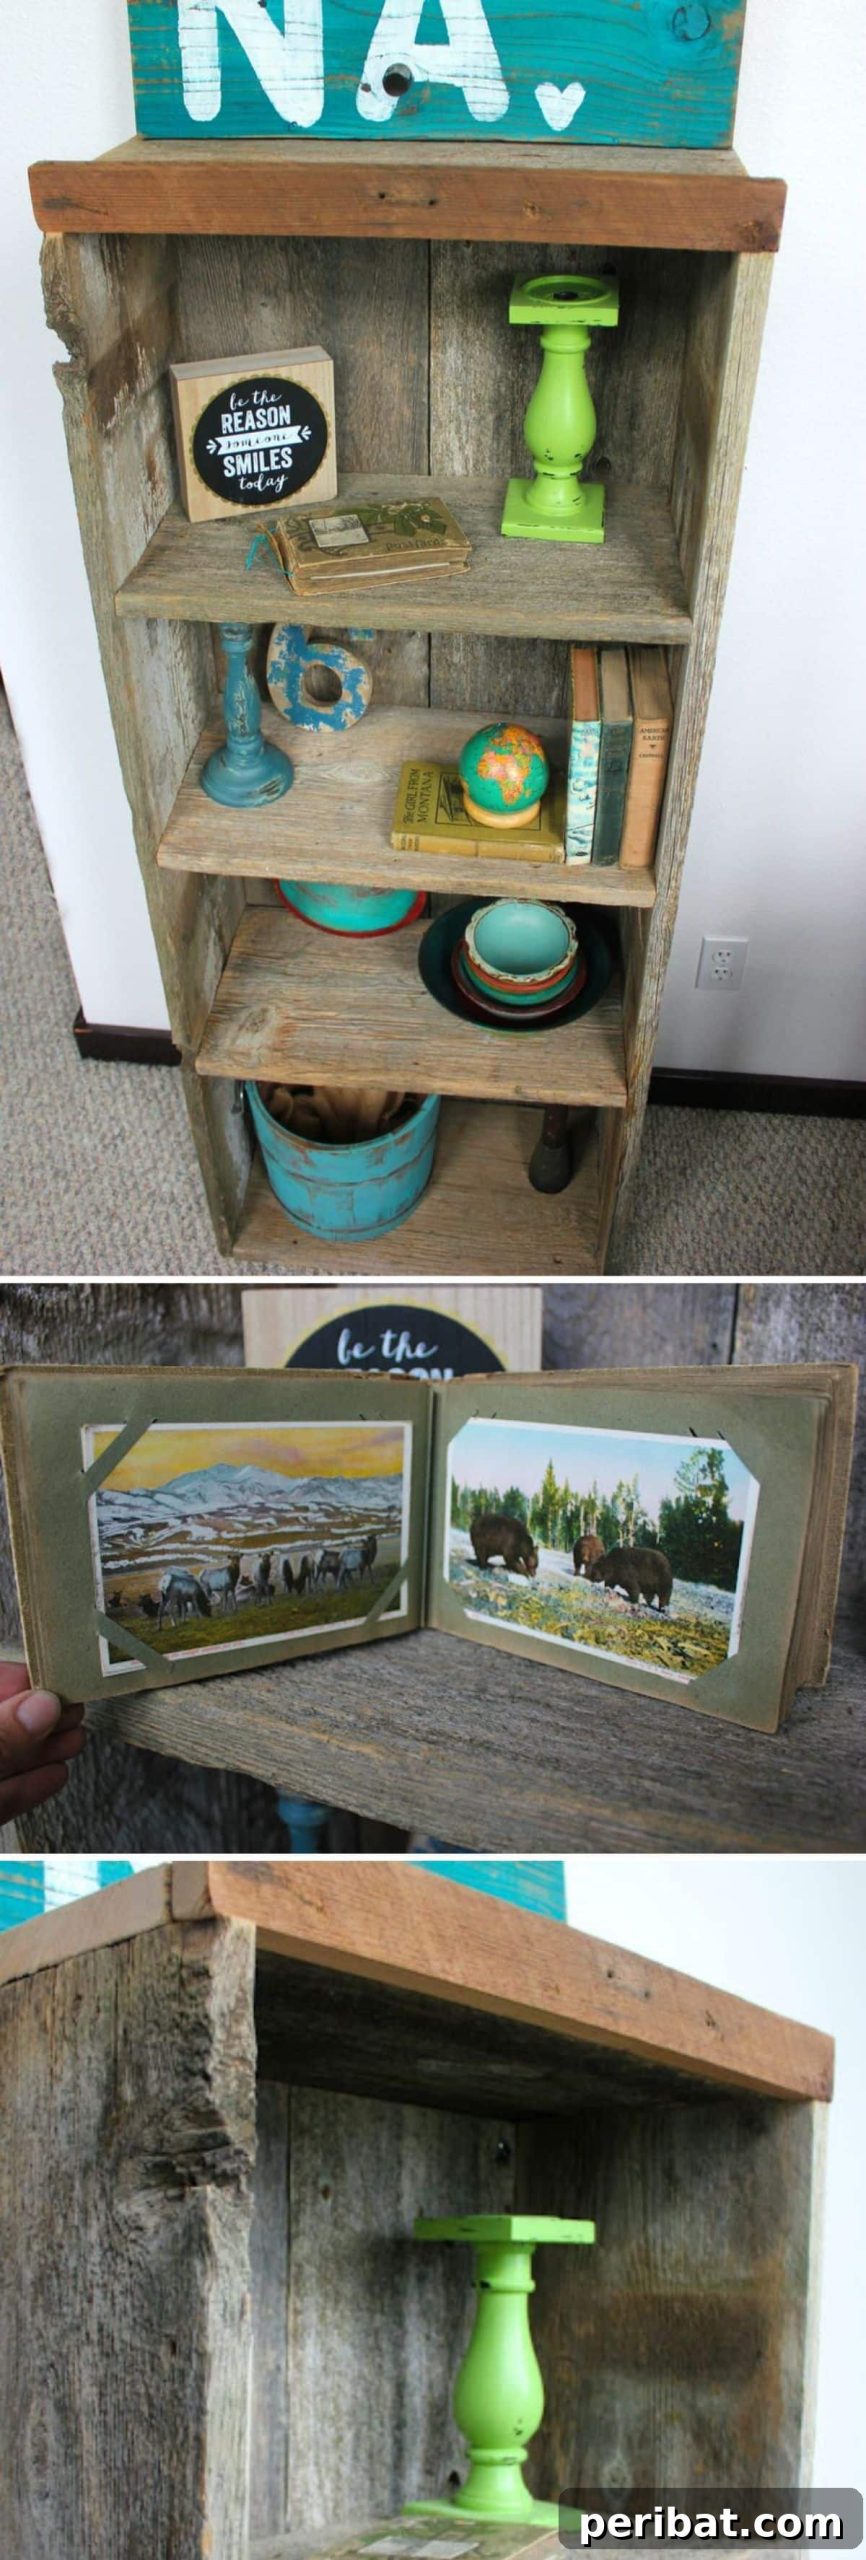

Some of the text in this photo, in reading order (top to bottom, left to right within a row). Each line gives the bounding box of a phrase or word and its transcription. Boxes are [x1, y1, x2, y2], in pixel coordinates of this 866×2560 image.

[230, 389, 283, 411] be the
[221, 404, 291, 434] REASON
[223, 446, 293, 478] SMILES
[238, 472, 289, 493] today
[407, 768, 421, 790] FROM
[405, 791, 418, 811] GIRL
[416, 770, 434, 823] MONTANA
[337, 1327, 439, 1365] be the
